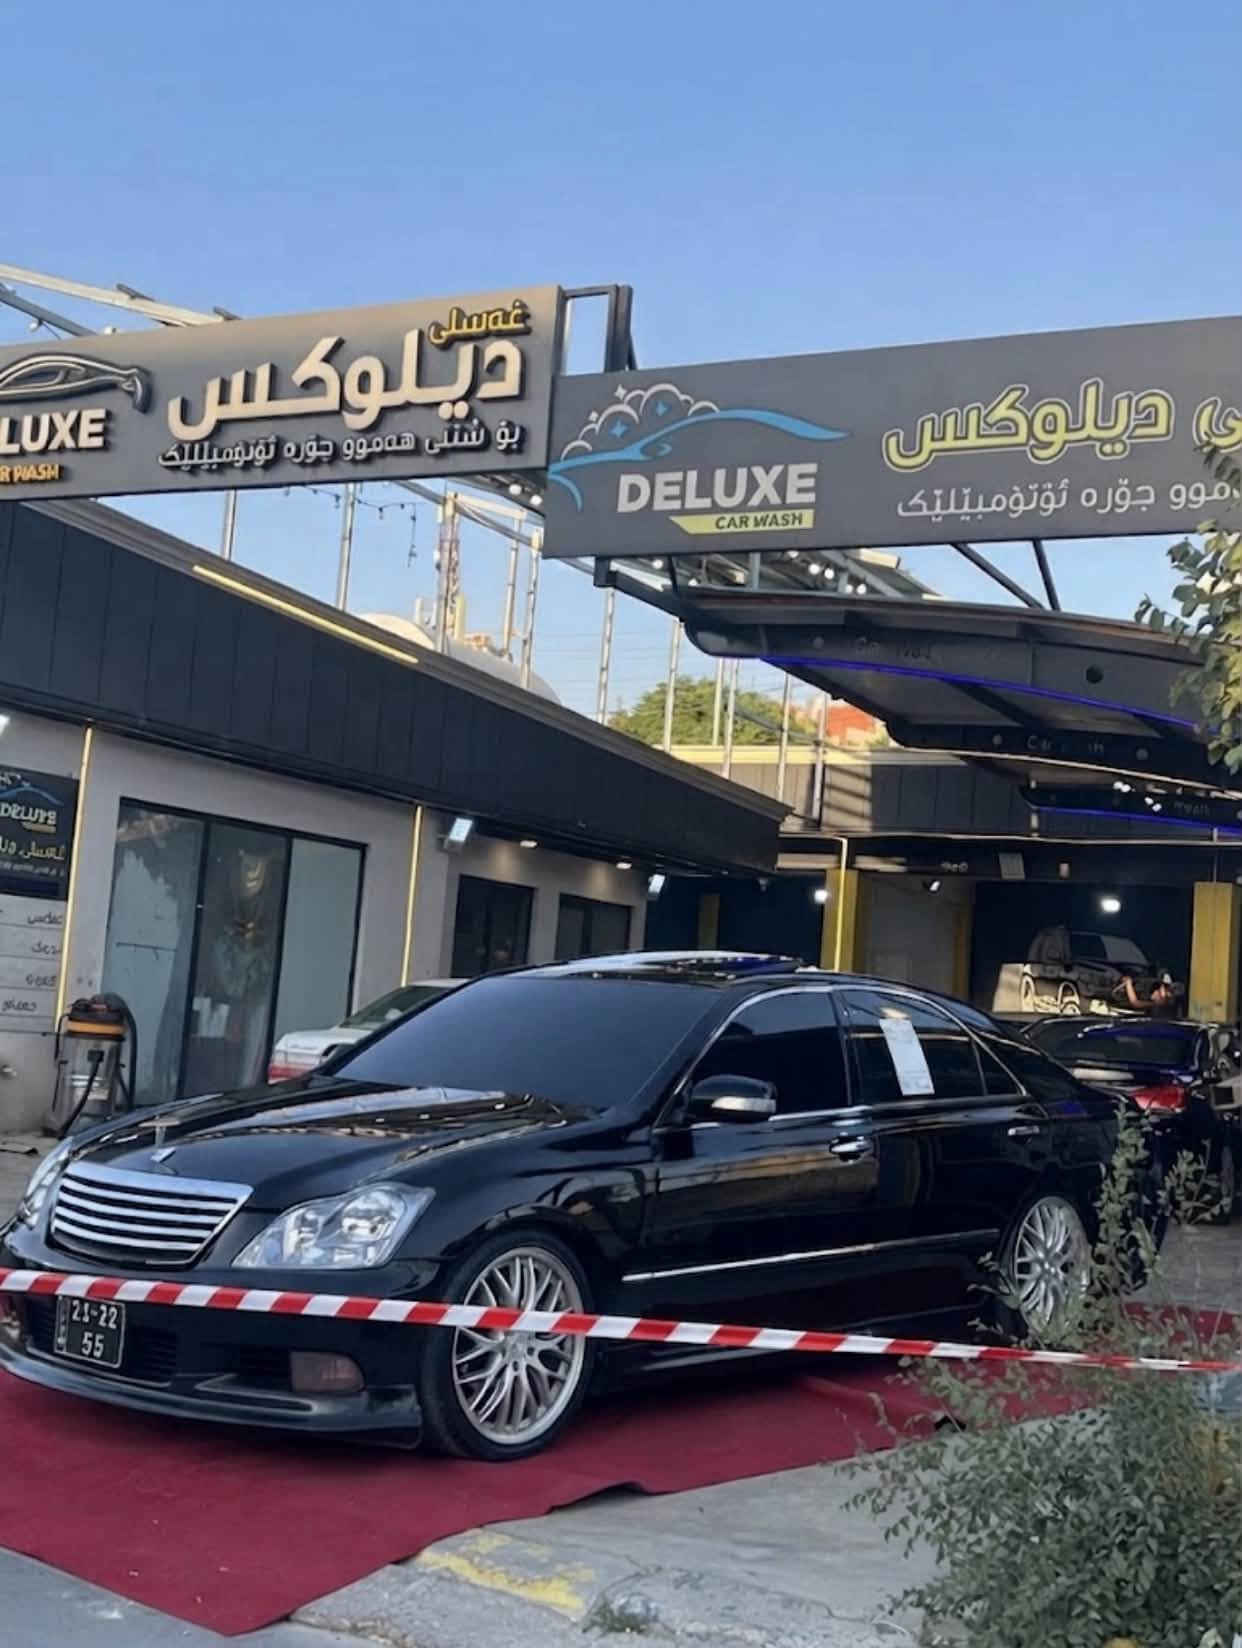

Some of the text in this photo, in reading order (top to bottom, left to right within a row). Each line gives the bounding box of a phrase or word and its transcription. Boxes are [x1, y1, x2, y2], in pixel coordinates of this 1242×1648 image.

[429, 299, 527, 345] غەسلی
[167, 329, 523, 441] دیلوکس
[883, 377, 1175, 473] دیلوکس
[13, 463, 60, 482] WASH
[616, 463, 819, 514] DELUXE
[715, 512, 804, 531] CAR WASH
[81, 1331, 105, 1358] 55
